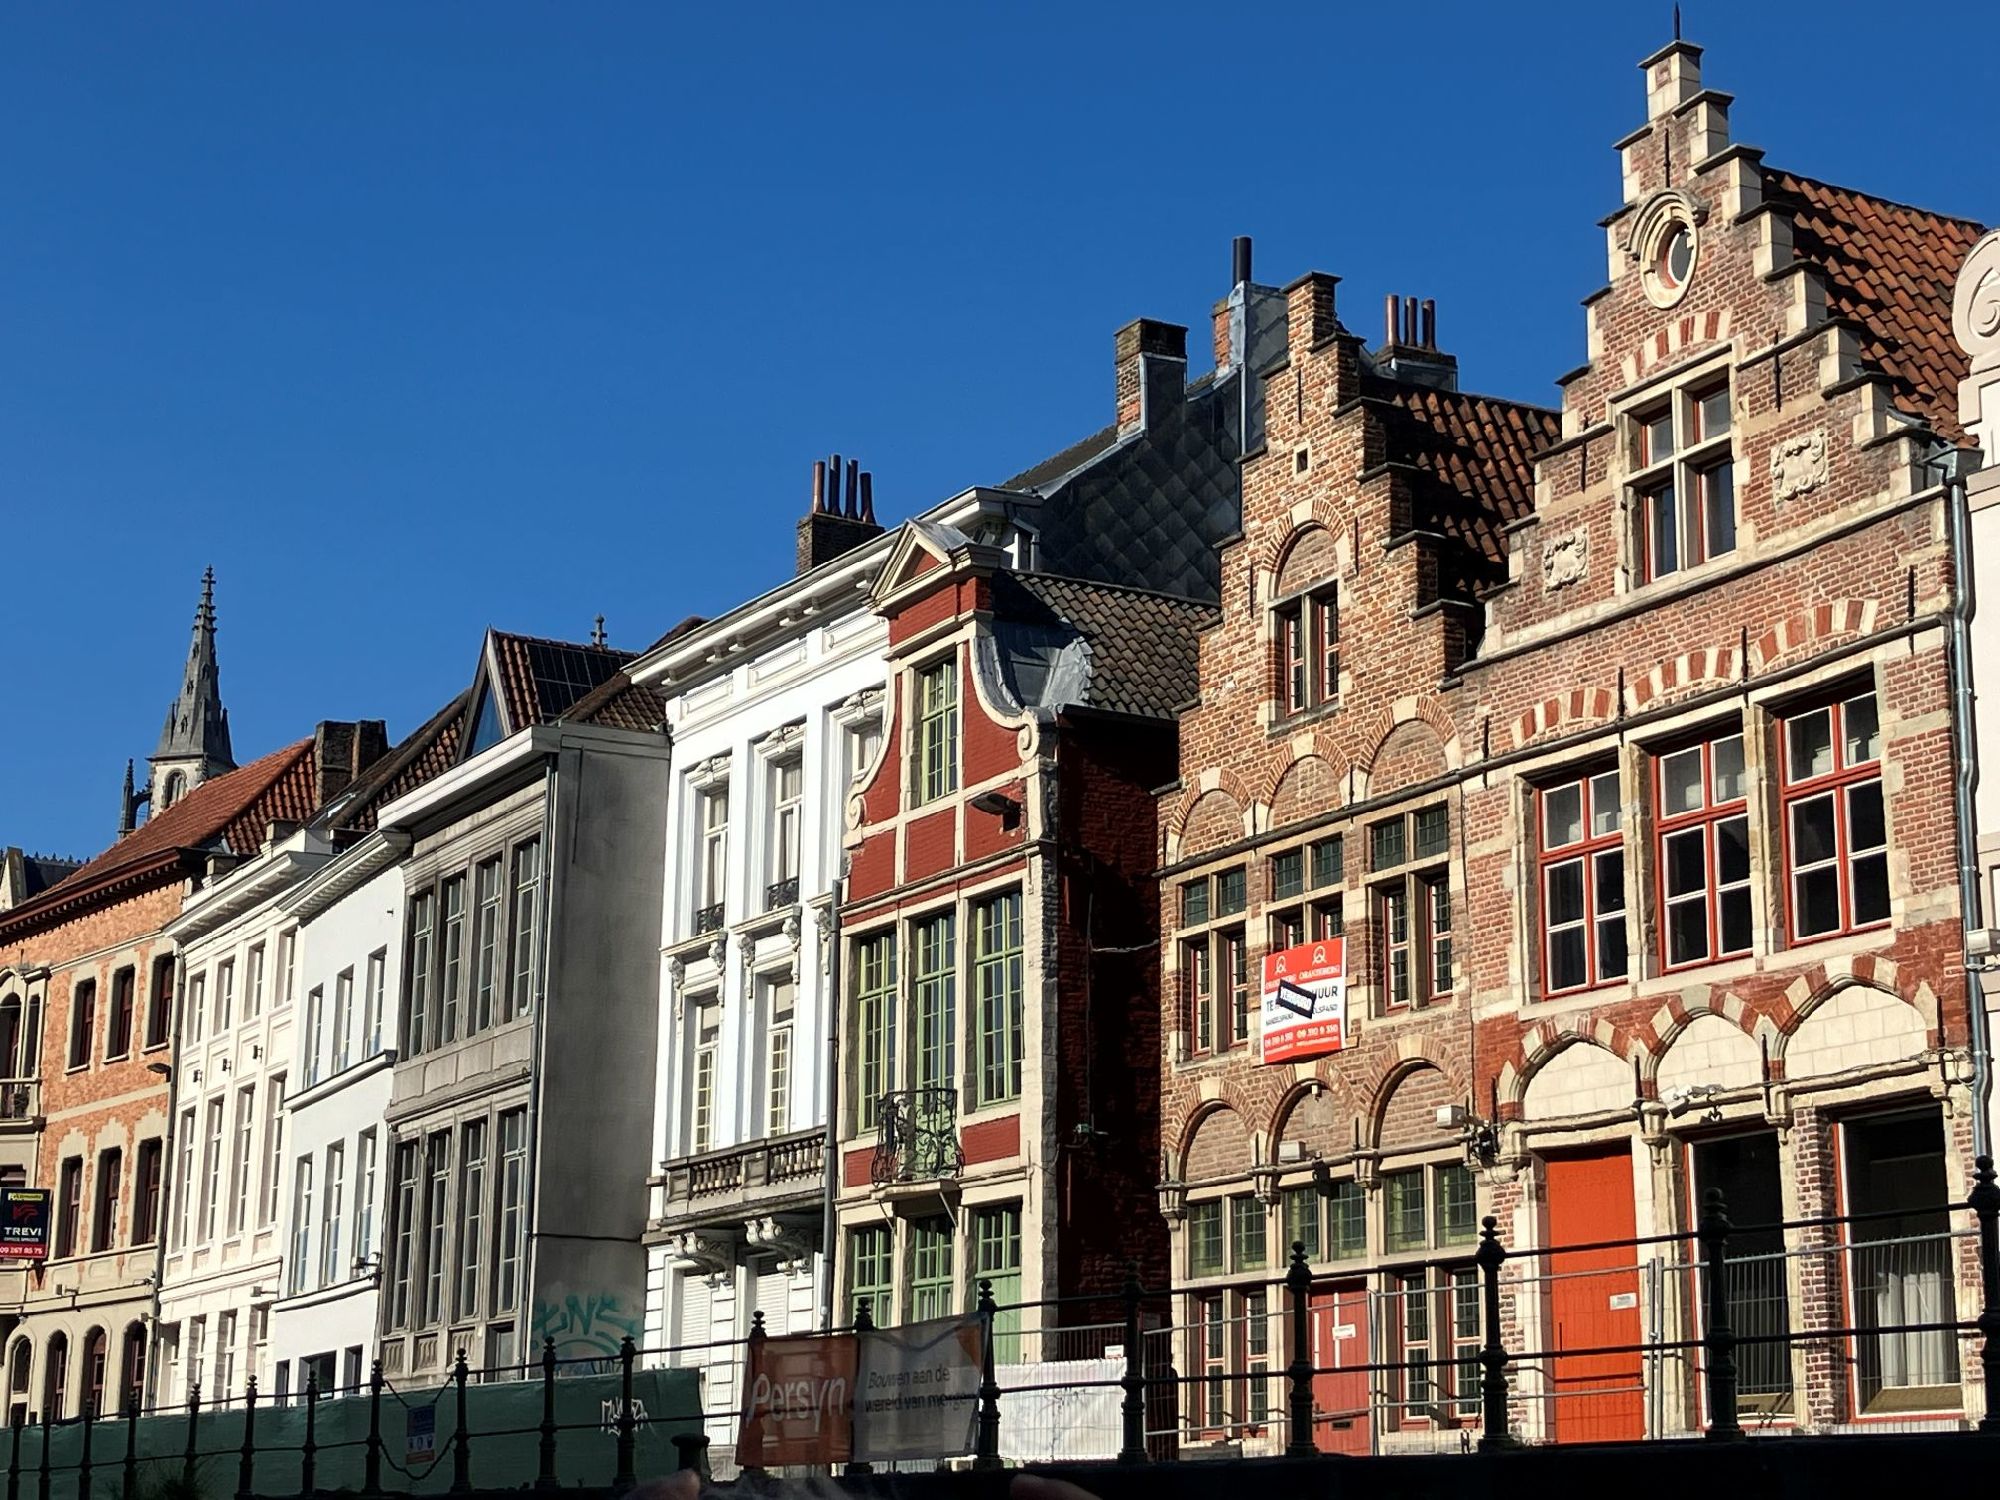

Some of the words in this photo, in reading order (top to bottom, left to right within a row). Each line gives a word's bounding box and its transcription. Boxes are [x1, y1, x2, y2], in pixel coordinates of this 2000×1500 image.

[3, 1226, 42, 1237] TREVI
[868, 1371, 910, 1389] Bouwen
[912, 1368, 933, 1385] aan
[935, 1363, 951, 1383] de
[745, 1372, 846, 1432] Persyn
[865, 1392, 902, 1413] wereld
[904, 1397, 925, 1411] van
